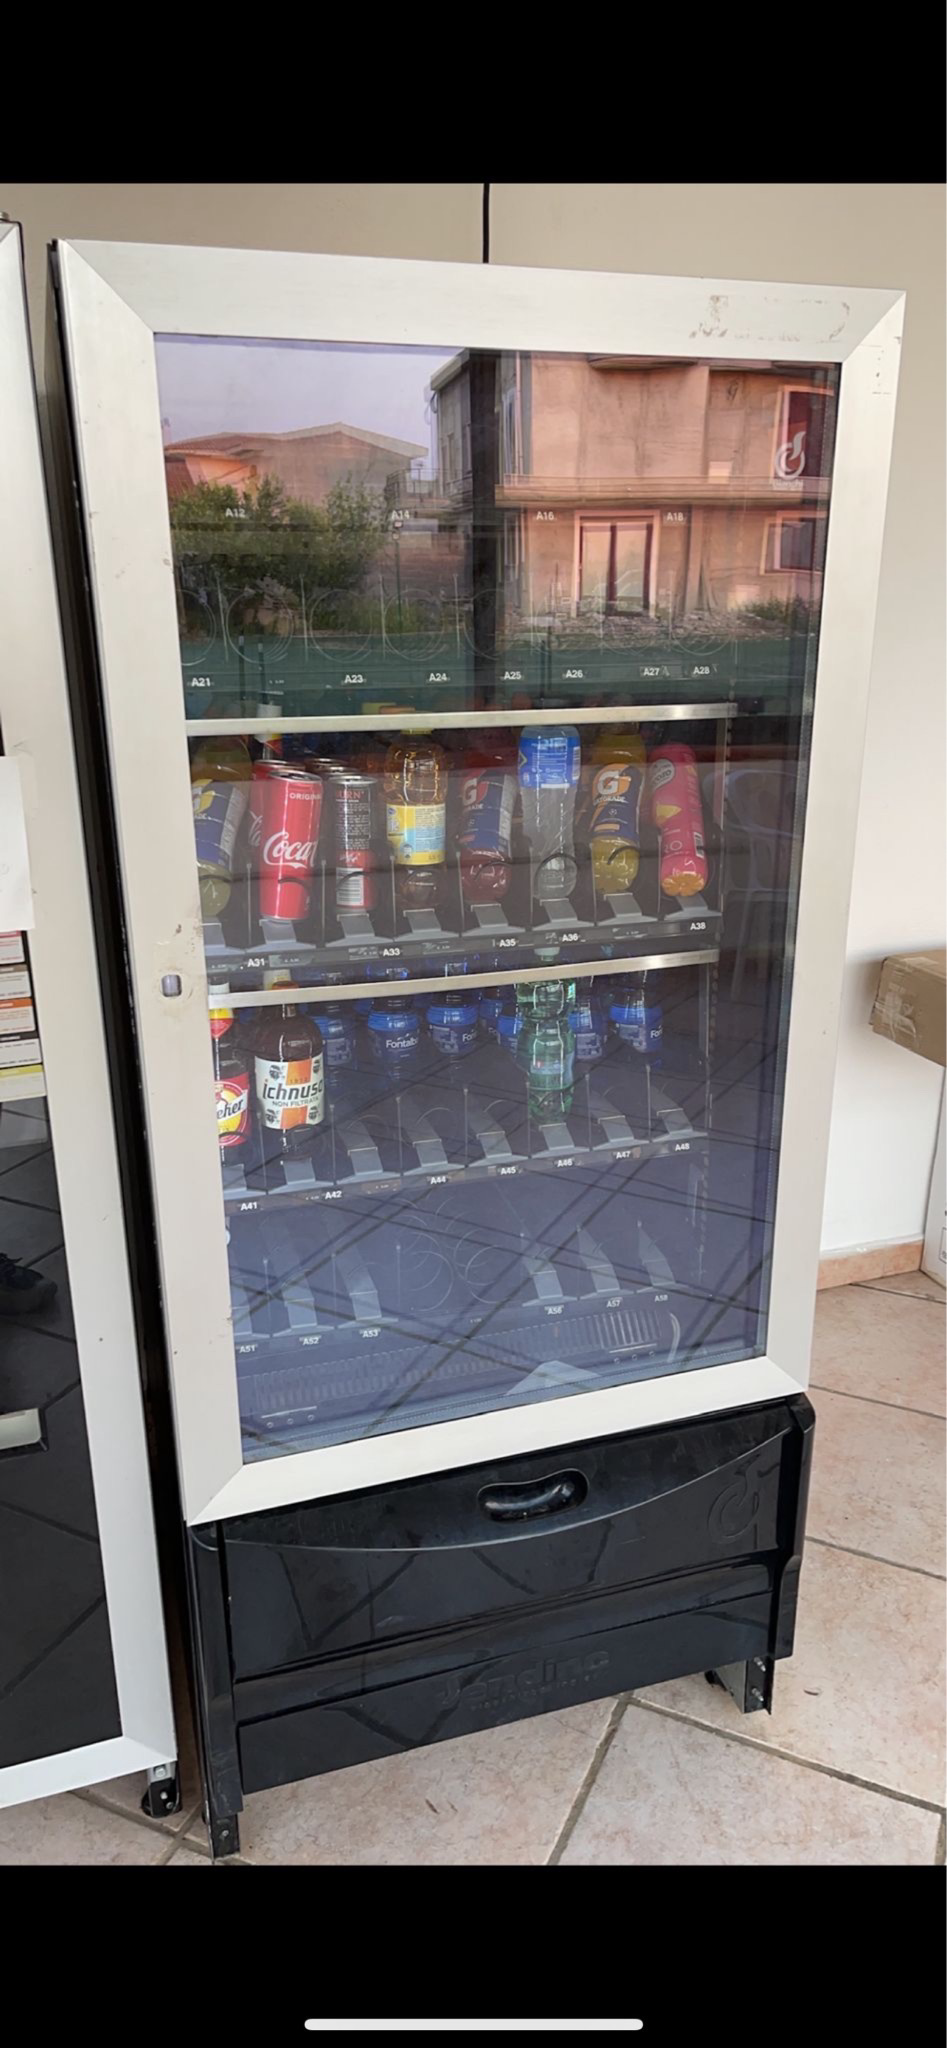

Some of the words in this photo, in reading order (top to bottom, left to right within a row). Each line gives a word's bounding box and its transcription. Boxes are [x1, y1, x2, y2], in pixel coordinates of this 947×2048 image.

[225, 508, 245, 518] A12
[391, 510, 410, 520] A14
[536, 511, 554, 520] A16
[666, 512, 684, 521] A18
[565, 669, 583, 679] A26
[643, 667, 660, 676] A27
[693, 666, 710, 675] A28
[344, 674, 364, 684] A23
[429, 672, 448, 682] A24
[504, 671, 521, 680] A25
[191, 677, 211, 687] A21
[690, 922, 706, 931] A38
[562, 933, 578, 942] A36
[499, 939, 516, 947] A35
[382, 947, 401, 957] A33
[247, 958, 265, 967] A31
[675, 1143, 690, 1151] A48
[616, 1151, 631, 1159] A47
[557, 1159, 573, 1167] A46
[500, 1167, 516, 1175] A45
[430, 1176, 446, 1185] A44
[324, 1190, 342, 1199] A42
[240, 1202, 258, 1211] A41
[362, 1330, 379, 1338] A53
[302, 1337, 320, 1346] A52
[239, 1345, 256, 1353] A51
